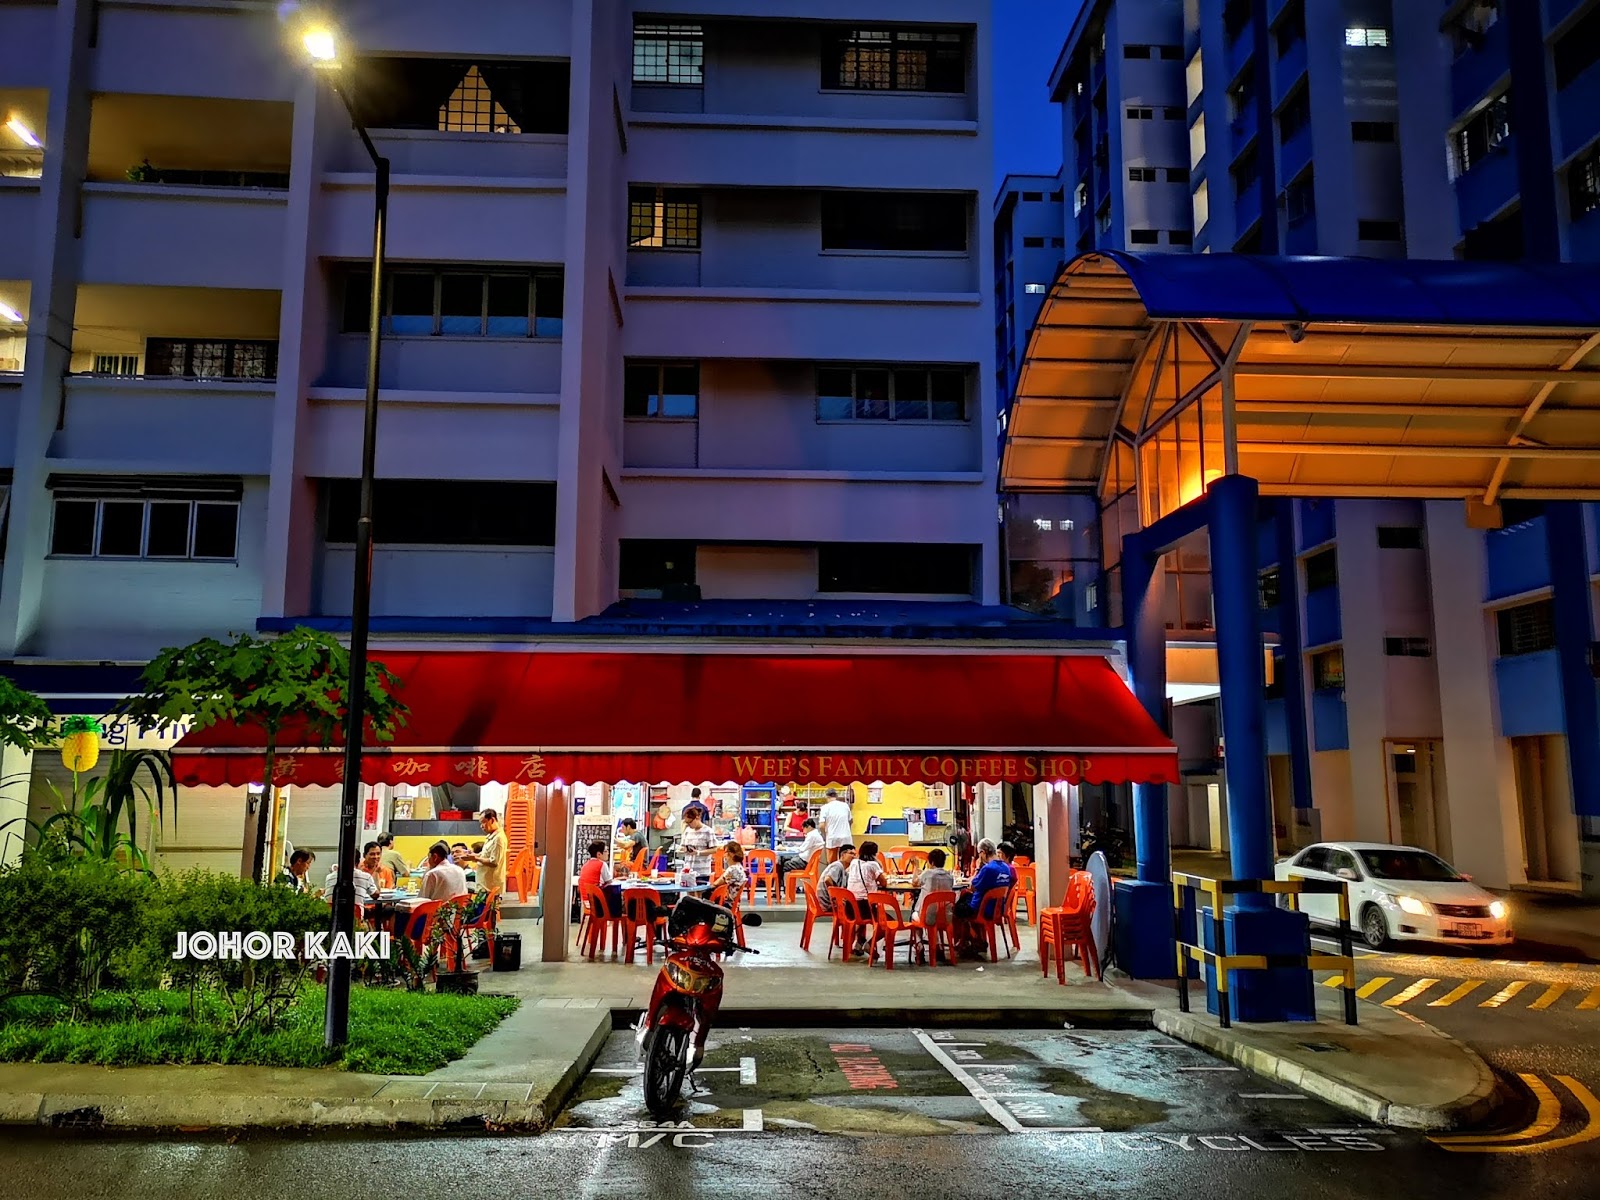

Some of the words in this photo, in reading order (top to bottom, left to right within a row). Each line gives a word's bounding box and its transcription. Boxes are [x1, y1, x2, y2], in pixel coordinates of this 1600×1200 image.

[817, 755, 915, 777] FAMILY
[920, 755, 1018, 778] COFFEE
[1023, 755, 1092, 778] SHOP
[597, 1133, 715, 1148] M/C
